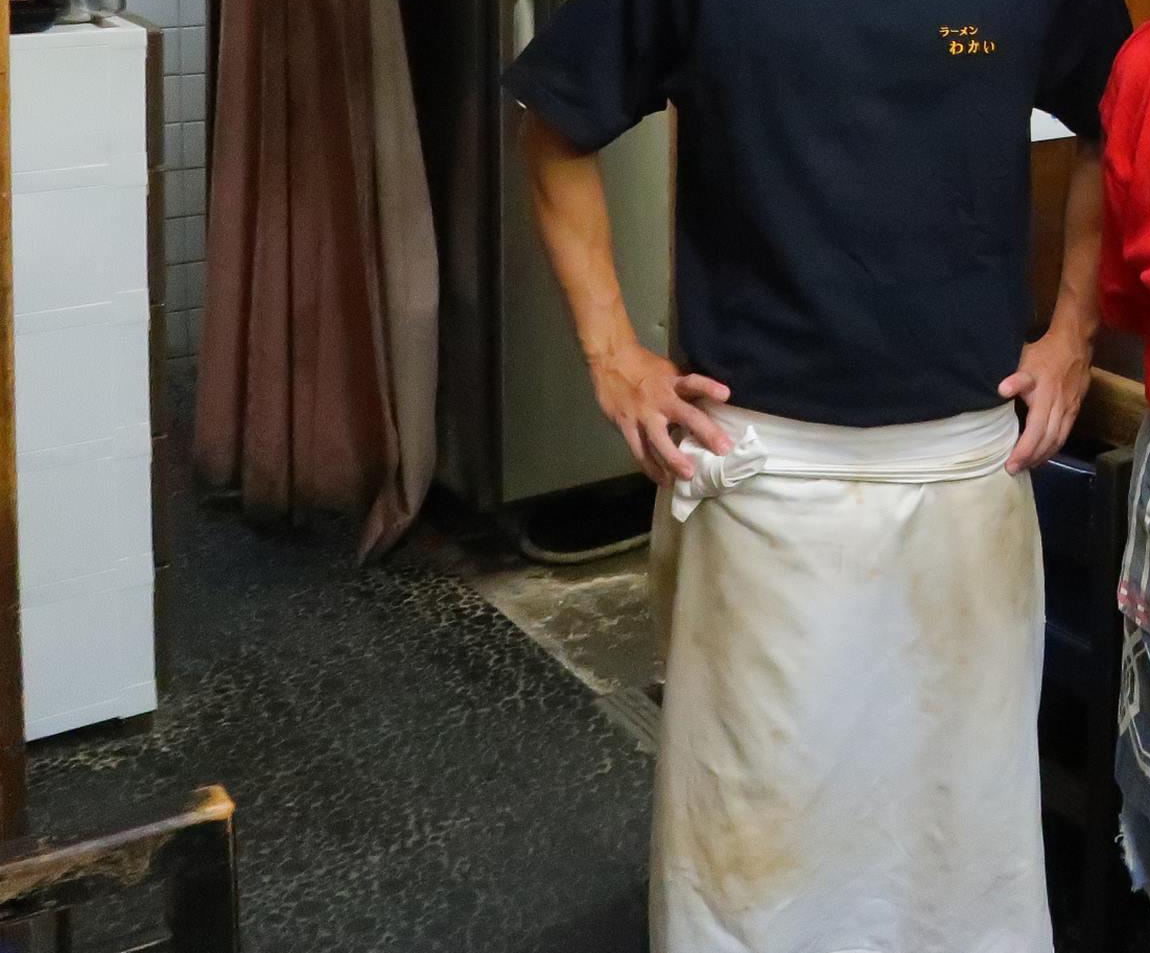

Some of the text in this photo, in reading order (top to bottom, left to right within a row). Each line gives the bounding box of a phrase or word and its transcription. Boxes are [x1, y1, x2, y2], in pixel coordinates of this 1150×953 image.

[939, 26, 979, 38] ラーメン
[949, 39, 995, 56] わかい
